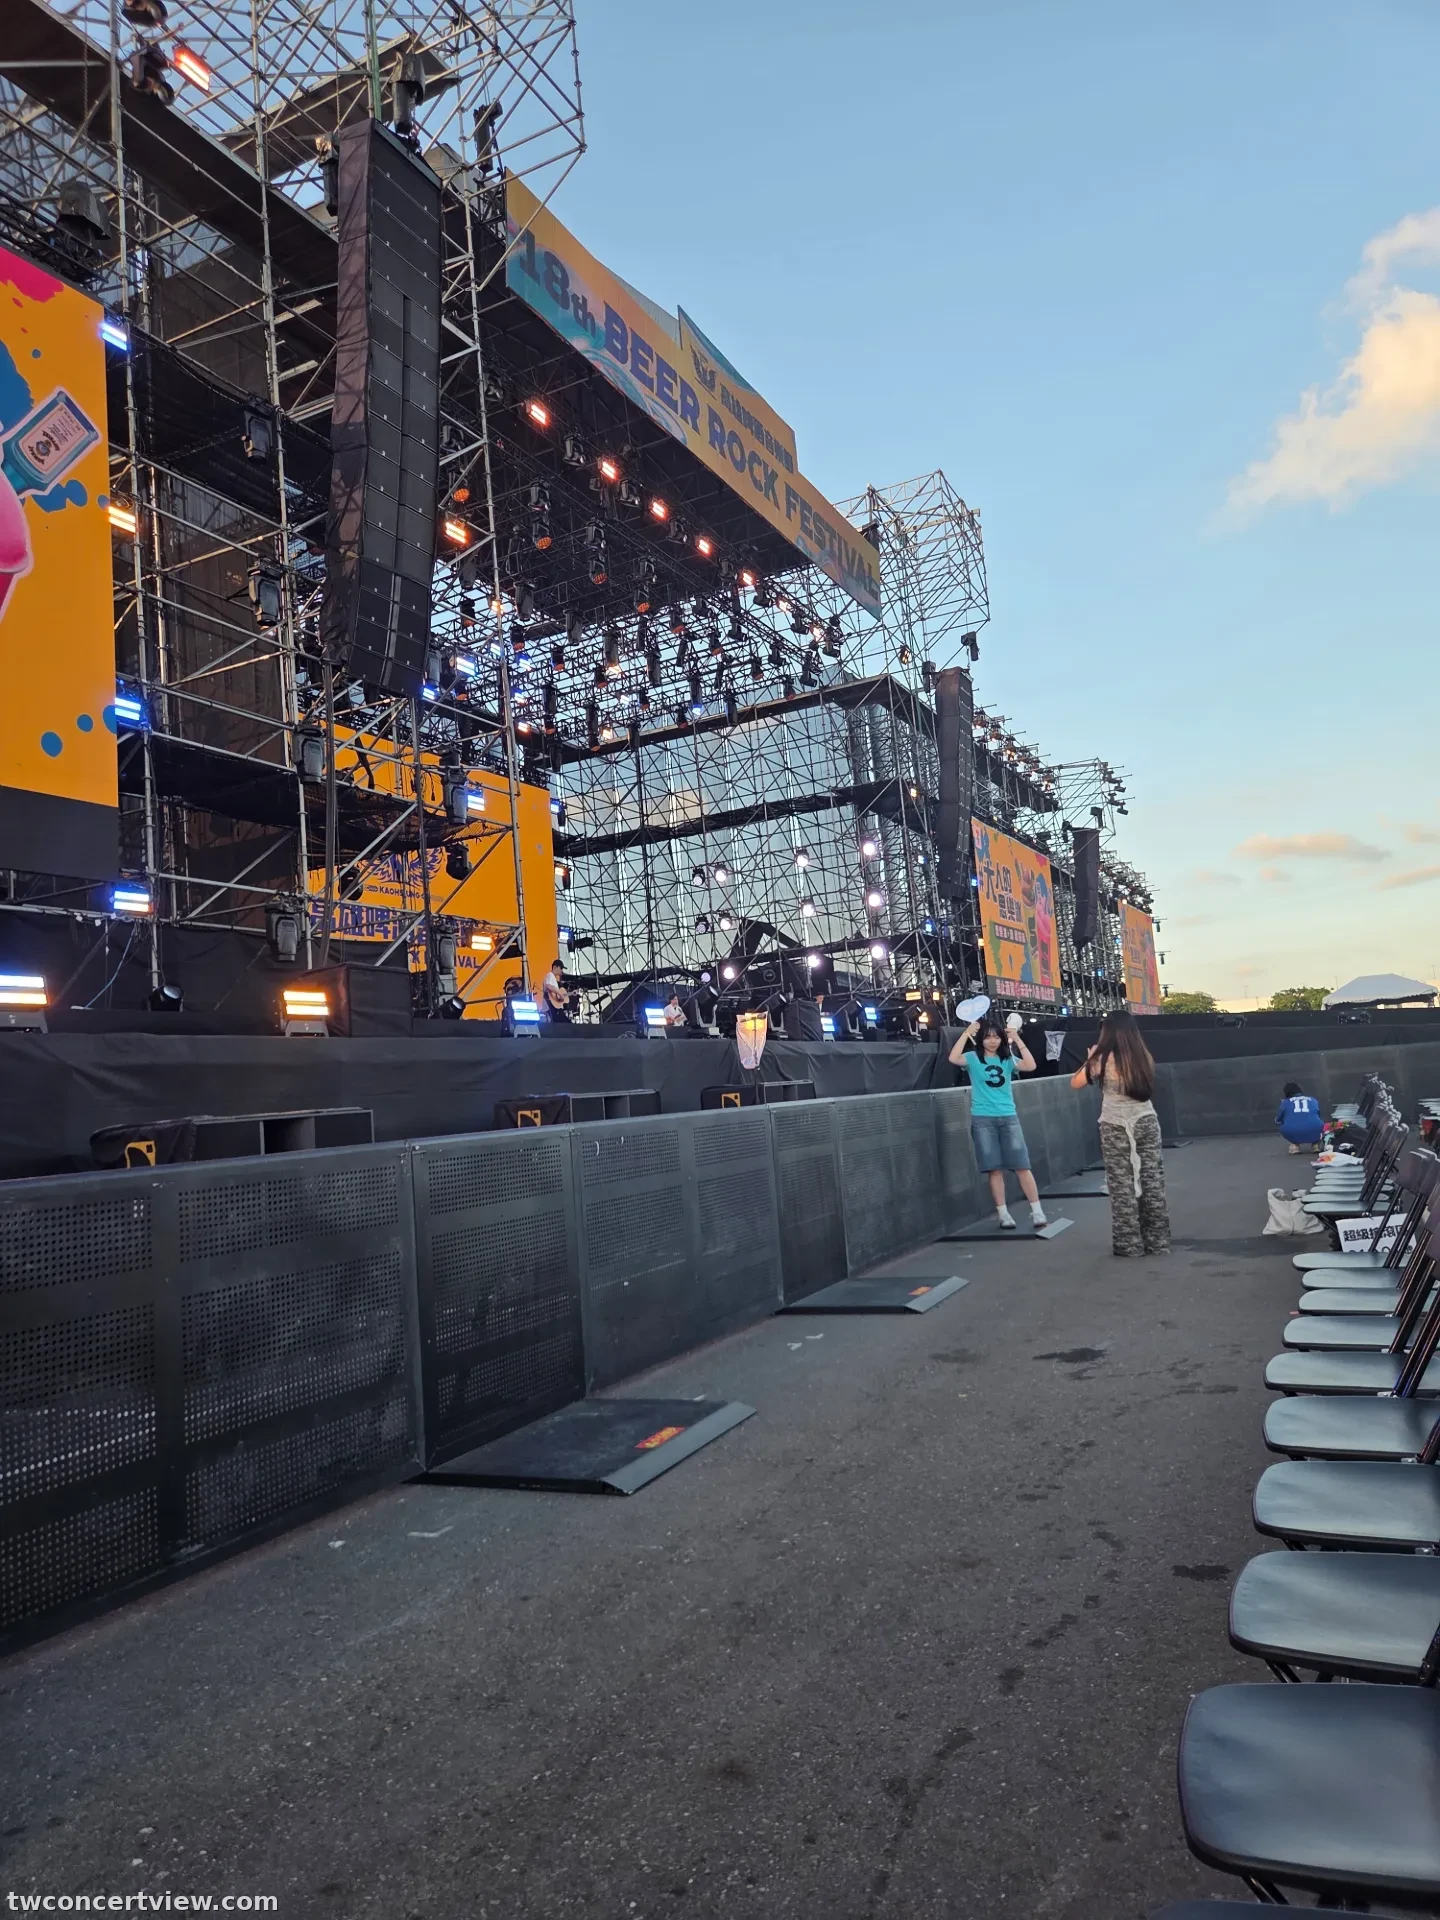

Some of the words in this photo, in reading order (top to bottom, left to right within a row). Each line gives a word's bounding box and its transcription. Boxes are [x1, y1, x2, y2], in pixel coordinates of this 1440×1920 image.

[519, 229, 597, 339] 18th
[603, 299, 701, 435] BEER
[707, 403, 782, 511] ROCK
[784, 481, 880, 597] FESTIVAL
[379, 885, 421, 899] KAOHSUNG
[984, 1064, 1006, 1088] 3
[1293, 1099, 1310, 1113] 11
